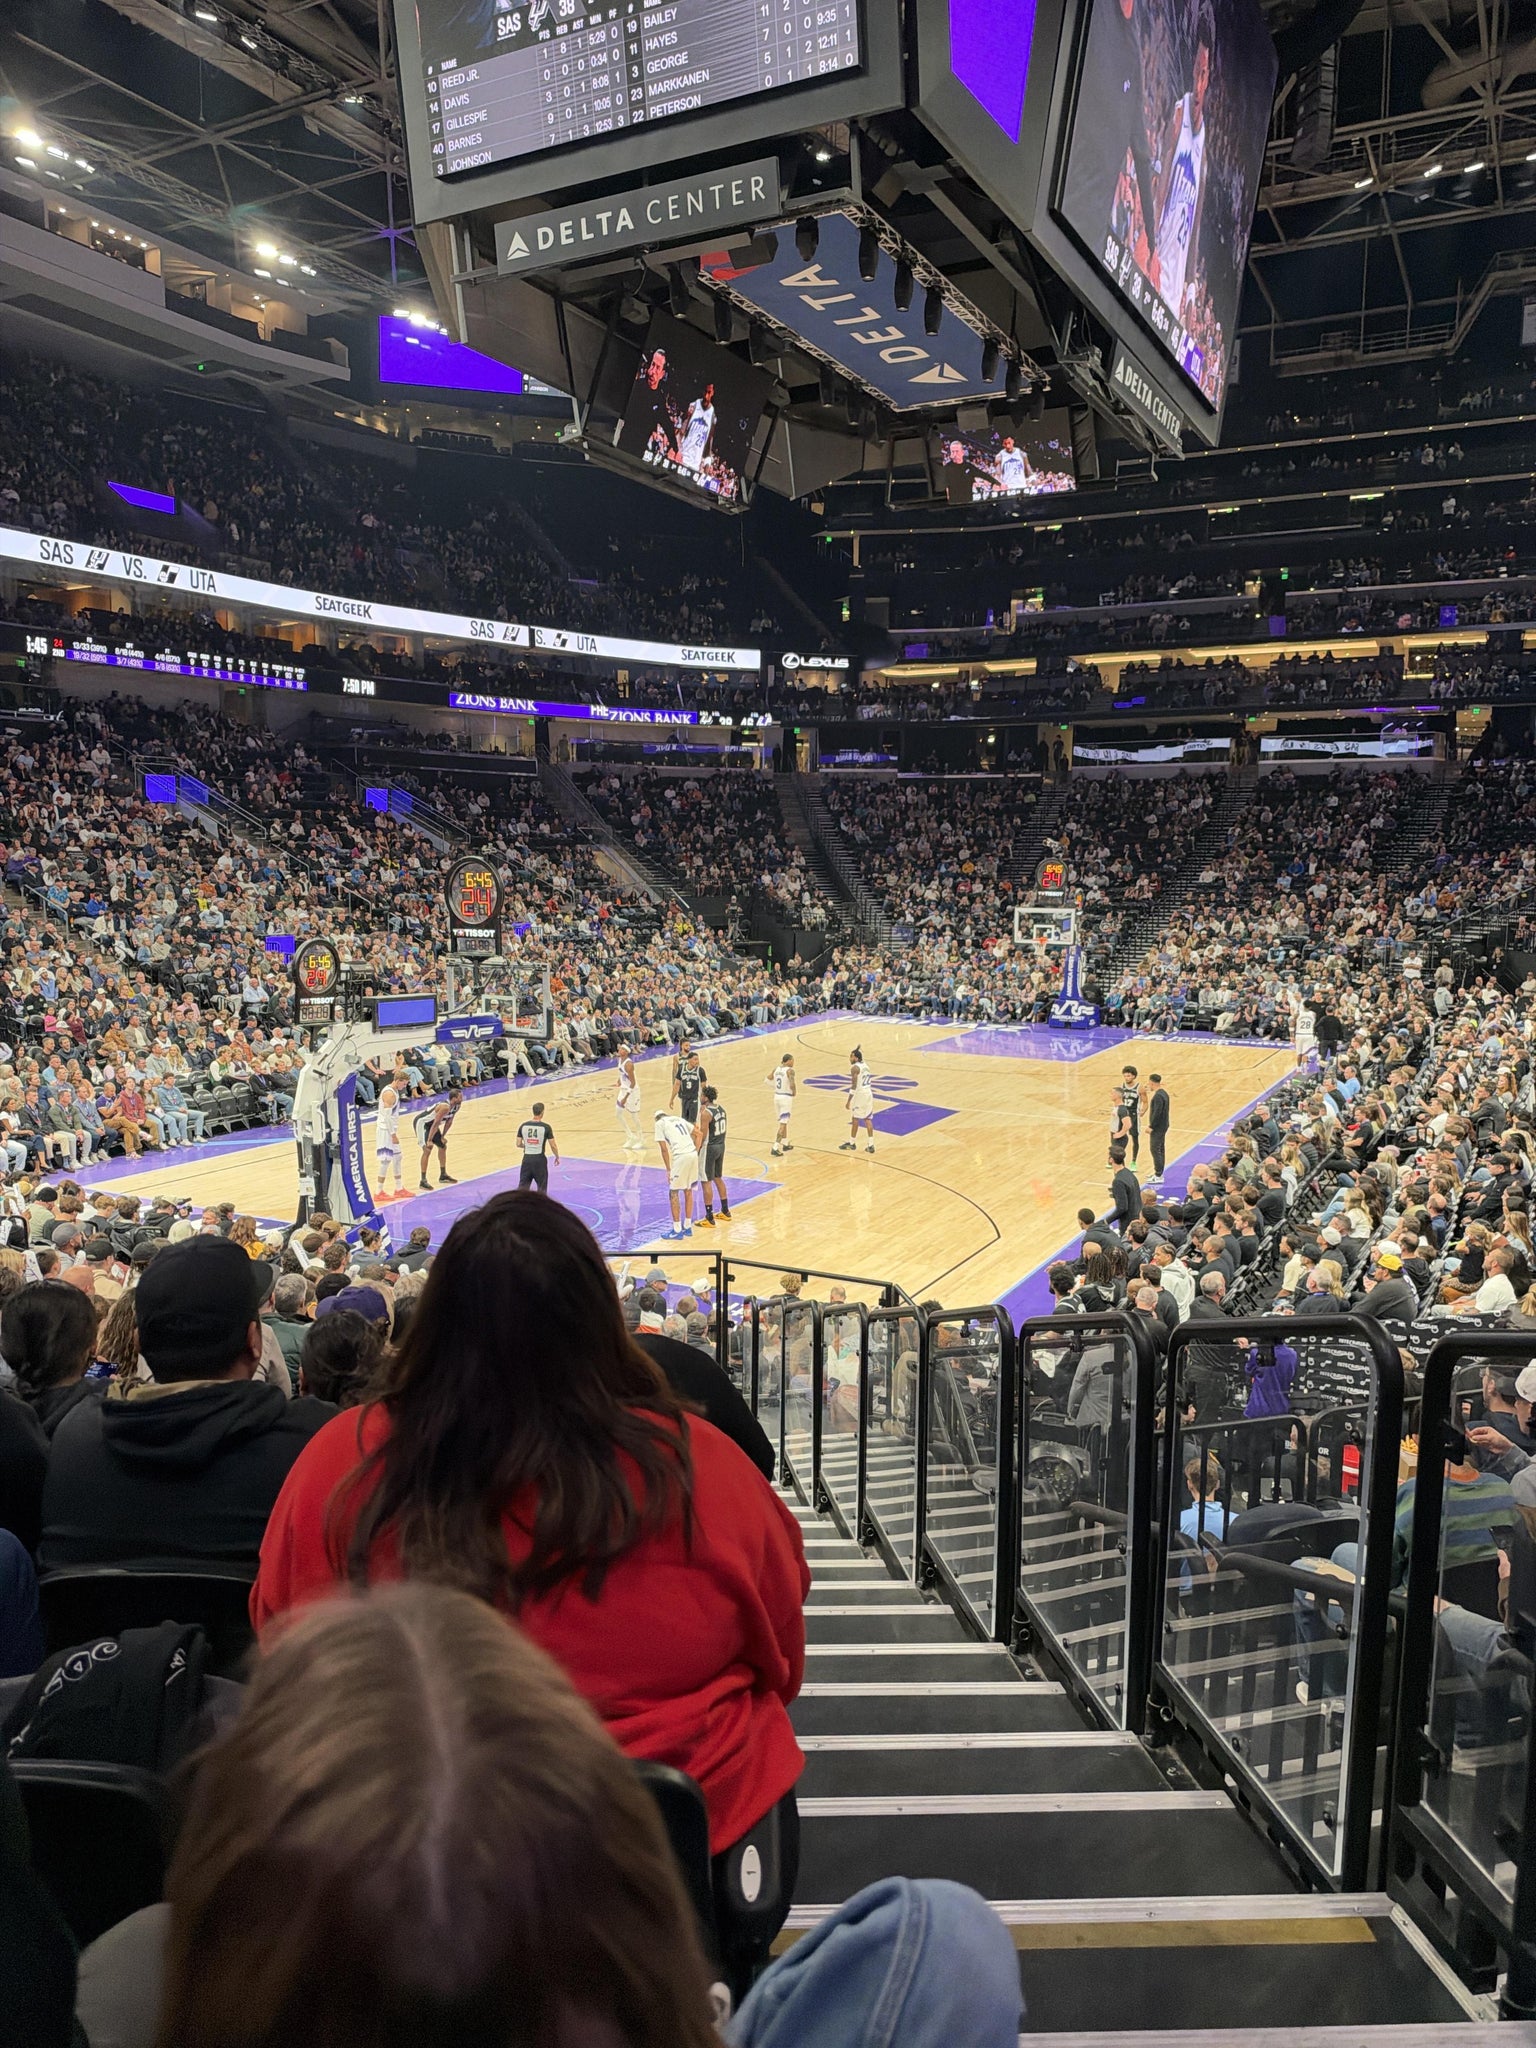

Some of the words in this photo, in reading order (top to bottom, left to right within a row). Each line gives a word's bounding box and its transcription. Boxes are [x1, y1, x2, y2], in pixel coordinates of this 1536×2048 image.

[559, 0, 575, 17] 38
[497, 12, 521, 36] SAS
[539, 30, 550, 40] PTS
[573, 19, 584, 30] AST
[627, 20, 637, 33] 19
[644, 8, 677, 28] BAILEY
[630, 43, 638, 55] 11
[645, 31, 678, 51] HAYES
[761, 4, 769, 17] 11
[783, 0, 790, 11] 2
[632, 65, 638, 77] 3
[647, 51, 688, 73] GEORGE
[763, 28, 769, 41] 7
[784, 22, 791, 34] 0
[804, 16, 811, 28] 0
[817, 9, 836, 25] 9:35
[845, 4, 849, 17] 1
[427, 81, 437, 93] 10
[442, 73, 465, 89] REED
[466, 69, 480, 82] JR.
[543, 48, 547, 59] 1
[560, 42, 566, 53] 8
[577, 38, 582, 48] 1
[589, 31, 605, 45] 5:29
[611, 26, 618, 38] 0
[631, 87, 643, 101] 23
[648, 69, 710, 97] MARKKANEN
[764, 52, 771, 64] 5
[786, 46, 791, 58] 1
[805, 41, 812, 53] 2
[818, 33, 837, 49] 12:11
[846, 29, 850, 42] 1
[429, 101, 439, 113] 14
[444, 93, 470, 110] DAVIS
[544, 69, 550, 80] 0
[562, 64, 568, 75] 0
[578, 59, 584, 70] 0
[591, 53, 607, 67] 0:34
[613, 49, 619, 60] 0
[633, 110, 644, 123] 22
[650, 94, 701, 118] PETERSON
[765, 75, 772, 87] 0
[788, 70, 792, 82] 1
[807, 64, 812, 76] 1
[819, 57, 838, 73] 8:14
[845, 53, 853, 65] 0
[432, 122, 440, 134] 17
[446, 109, 488, 131] GILLESPIE
[546, 91, 552, 102] 3
[564, 86, 570, 97] 0
[581, 82, 585, 92] 1
[592, 75, 609, 89] 8:08
[615, 71, 620, 82] 1
[433, 142, 444, 155] 40
[448, 132, 482, 152] BARNES
[548, 113, 554, 124] 9
[565, 108, 572, 119] 0
[582, 103, 587, 114] 1
[616, 93, 622, 105] 0
[437, 164, 443, 175] 3
[450, 151, 492, 172] JOHNSON
[549, 133, 555, 144] 7
[568, 130, 572, 140] 1
[583, 125, 589, 136] 3
[595, 118, 612, 132] 12:53
[618, 115, 624, 126] 3
[537, 207, 635, 250] DELTA
[646, 176, 766, 224] CENTER
[1105, 235, 1119, 269] SAS
[779, 263, 930, 365] DELTA
[1124, 365, 1152, 410] DELTA
[1152, 397, 1180, 439] CENTER
[39, 539, 74, 564] SAS
[122, 555, 147, 579] VS.
[190, 569, 217, 592] UTA
[315, 596, 372, 619] SEATGEEK
[53, 638, 63, 648] 24
[470, 620, 495, 639] SAS
[576, 635, 597, 652] UTA
[681, 648, 736, 663] SEATGEEK
[801, 657, 850, 668] LEXUS
[342, 678, 360, 694] 7:50
[361, 680, 375, 696] PM
[456, 693, 497, 708] ZIONS
[500, 698, 538, 712] BANK
[609, 711, 651, 722] ZIONS
[655, 712, 692, 725] BANK
[1046, 864, 1063, 873] 6:45
[466, 872, 493, 888] 6:45
[1042, 872, 1062, 888] 24
[461, 888, 492, 916] 24
[465, 929, 495, 937] TISSOT
[309, 954, 331, 969] 6:45
[307, 969, 327, 987] 24
[310, 997, 334, 1005] TISSOT
[1300, 1020, 1311, 1029] 28
[686, 1081, 692, 1089] 3
[776, 1078, 782, 1089] 3
[861, 1074, 871, 1087] 22
[346, 1102, 357, 1141] FIRST
[675, 1123, 687, 1136] 11
[714, 1119, 726, 1136] 10
[527, 1128, 538, 1138] 24
[350, 1143, 367, 1203] AMERICA
